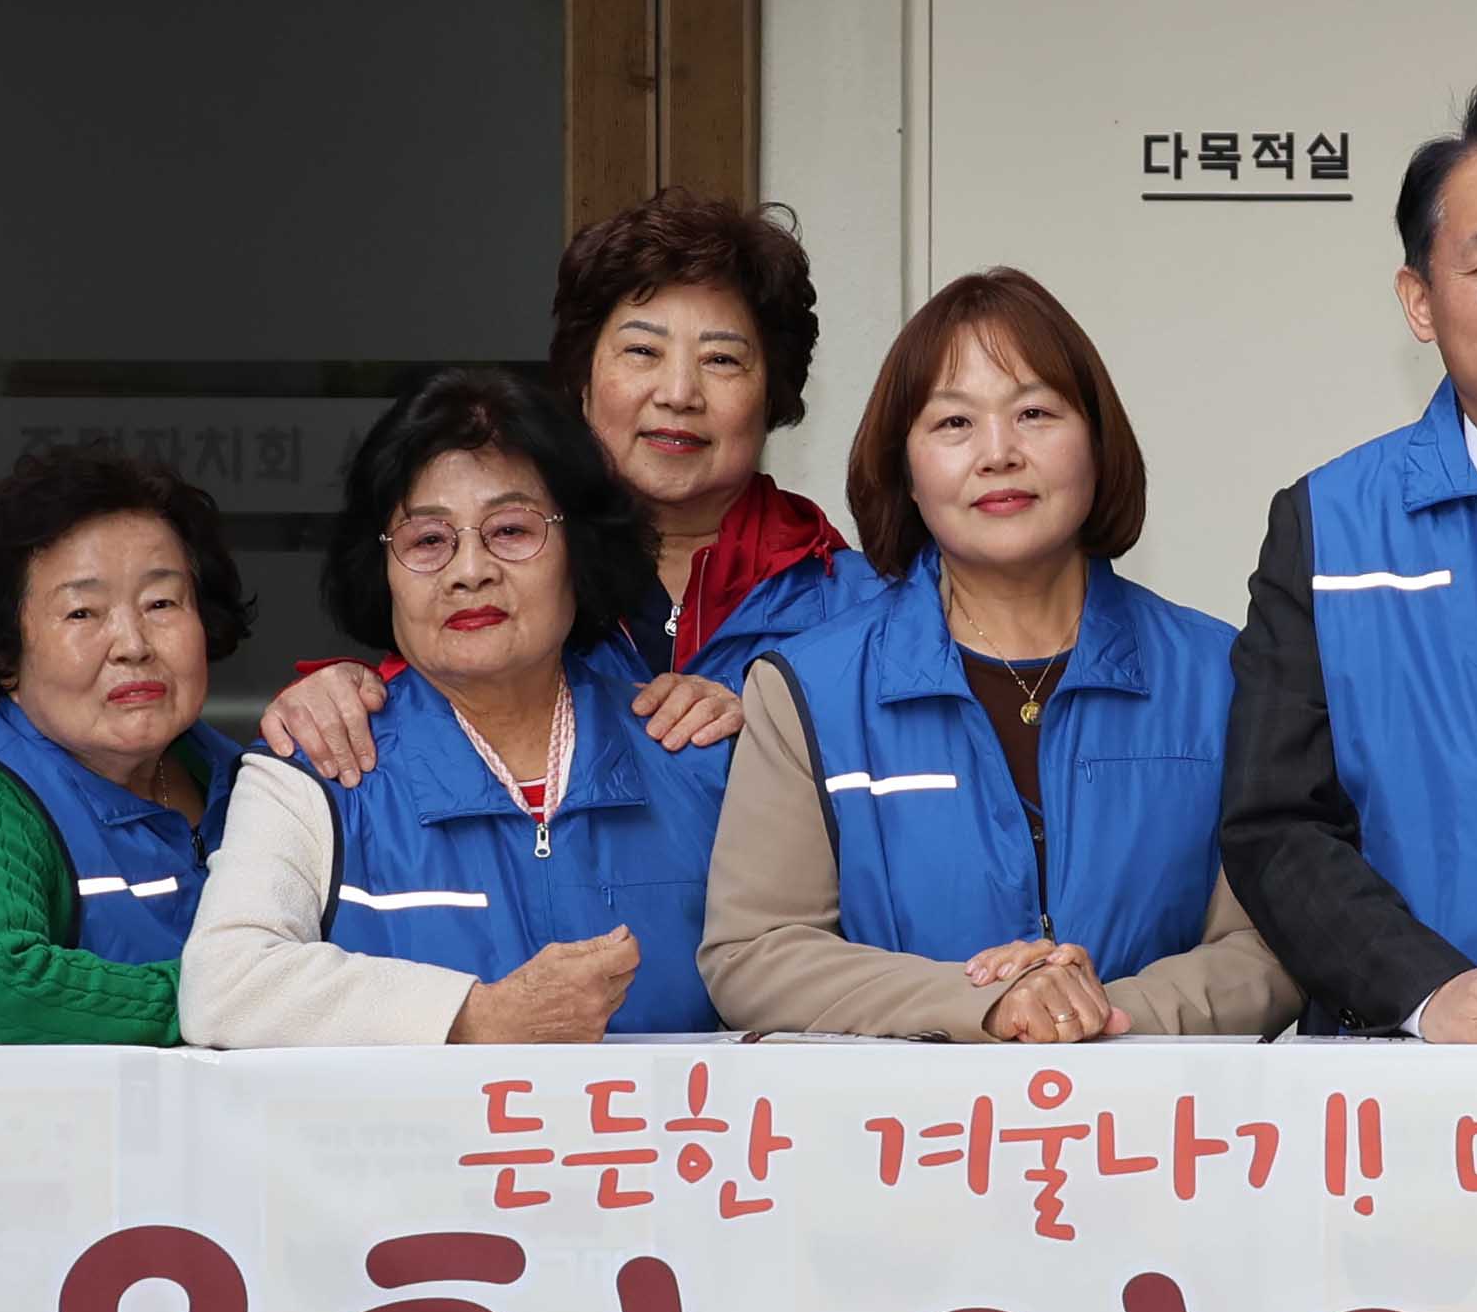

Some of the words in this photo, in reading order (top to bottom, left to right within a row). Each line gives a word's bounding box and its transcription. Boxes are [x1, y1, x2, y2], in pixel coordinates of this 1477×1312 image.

[1142, 132, 1353, 181] 다목적실
[460, 1063, 792, 1219] 든든한
[867, 1070, 1382, 1240] 겨울나기!
